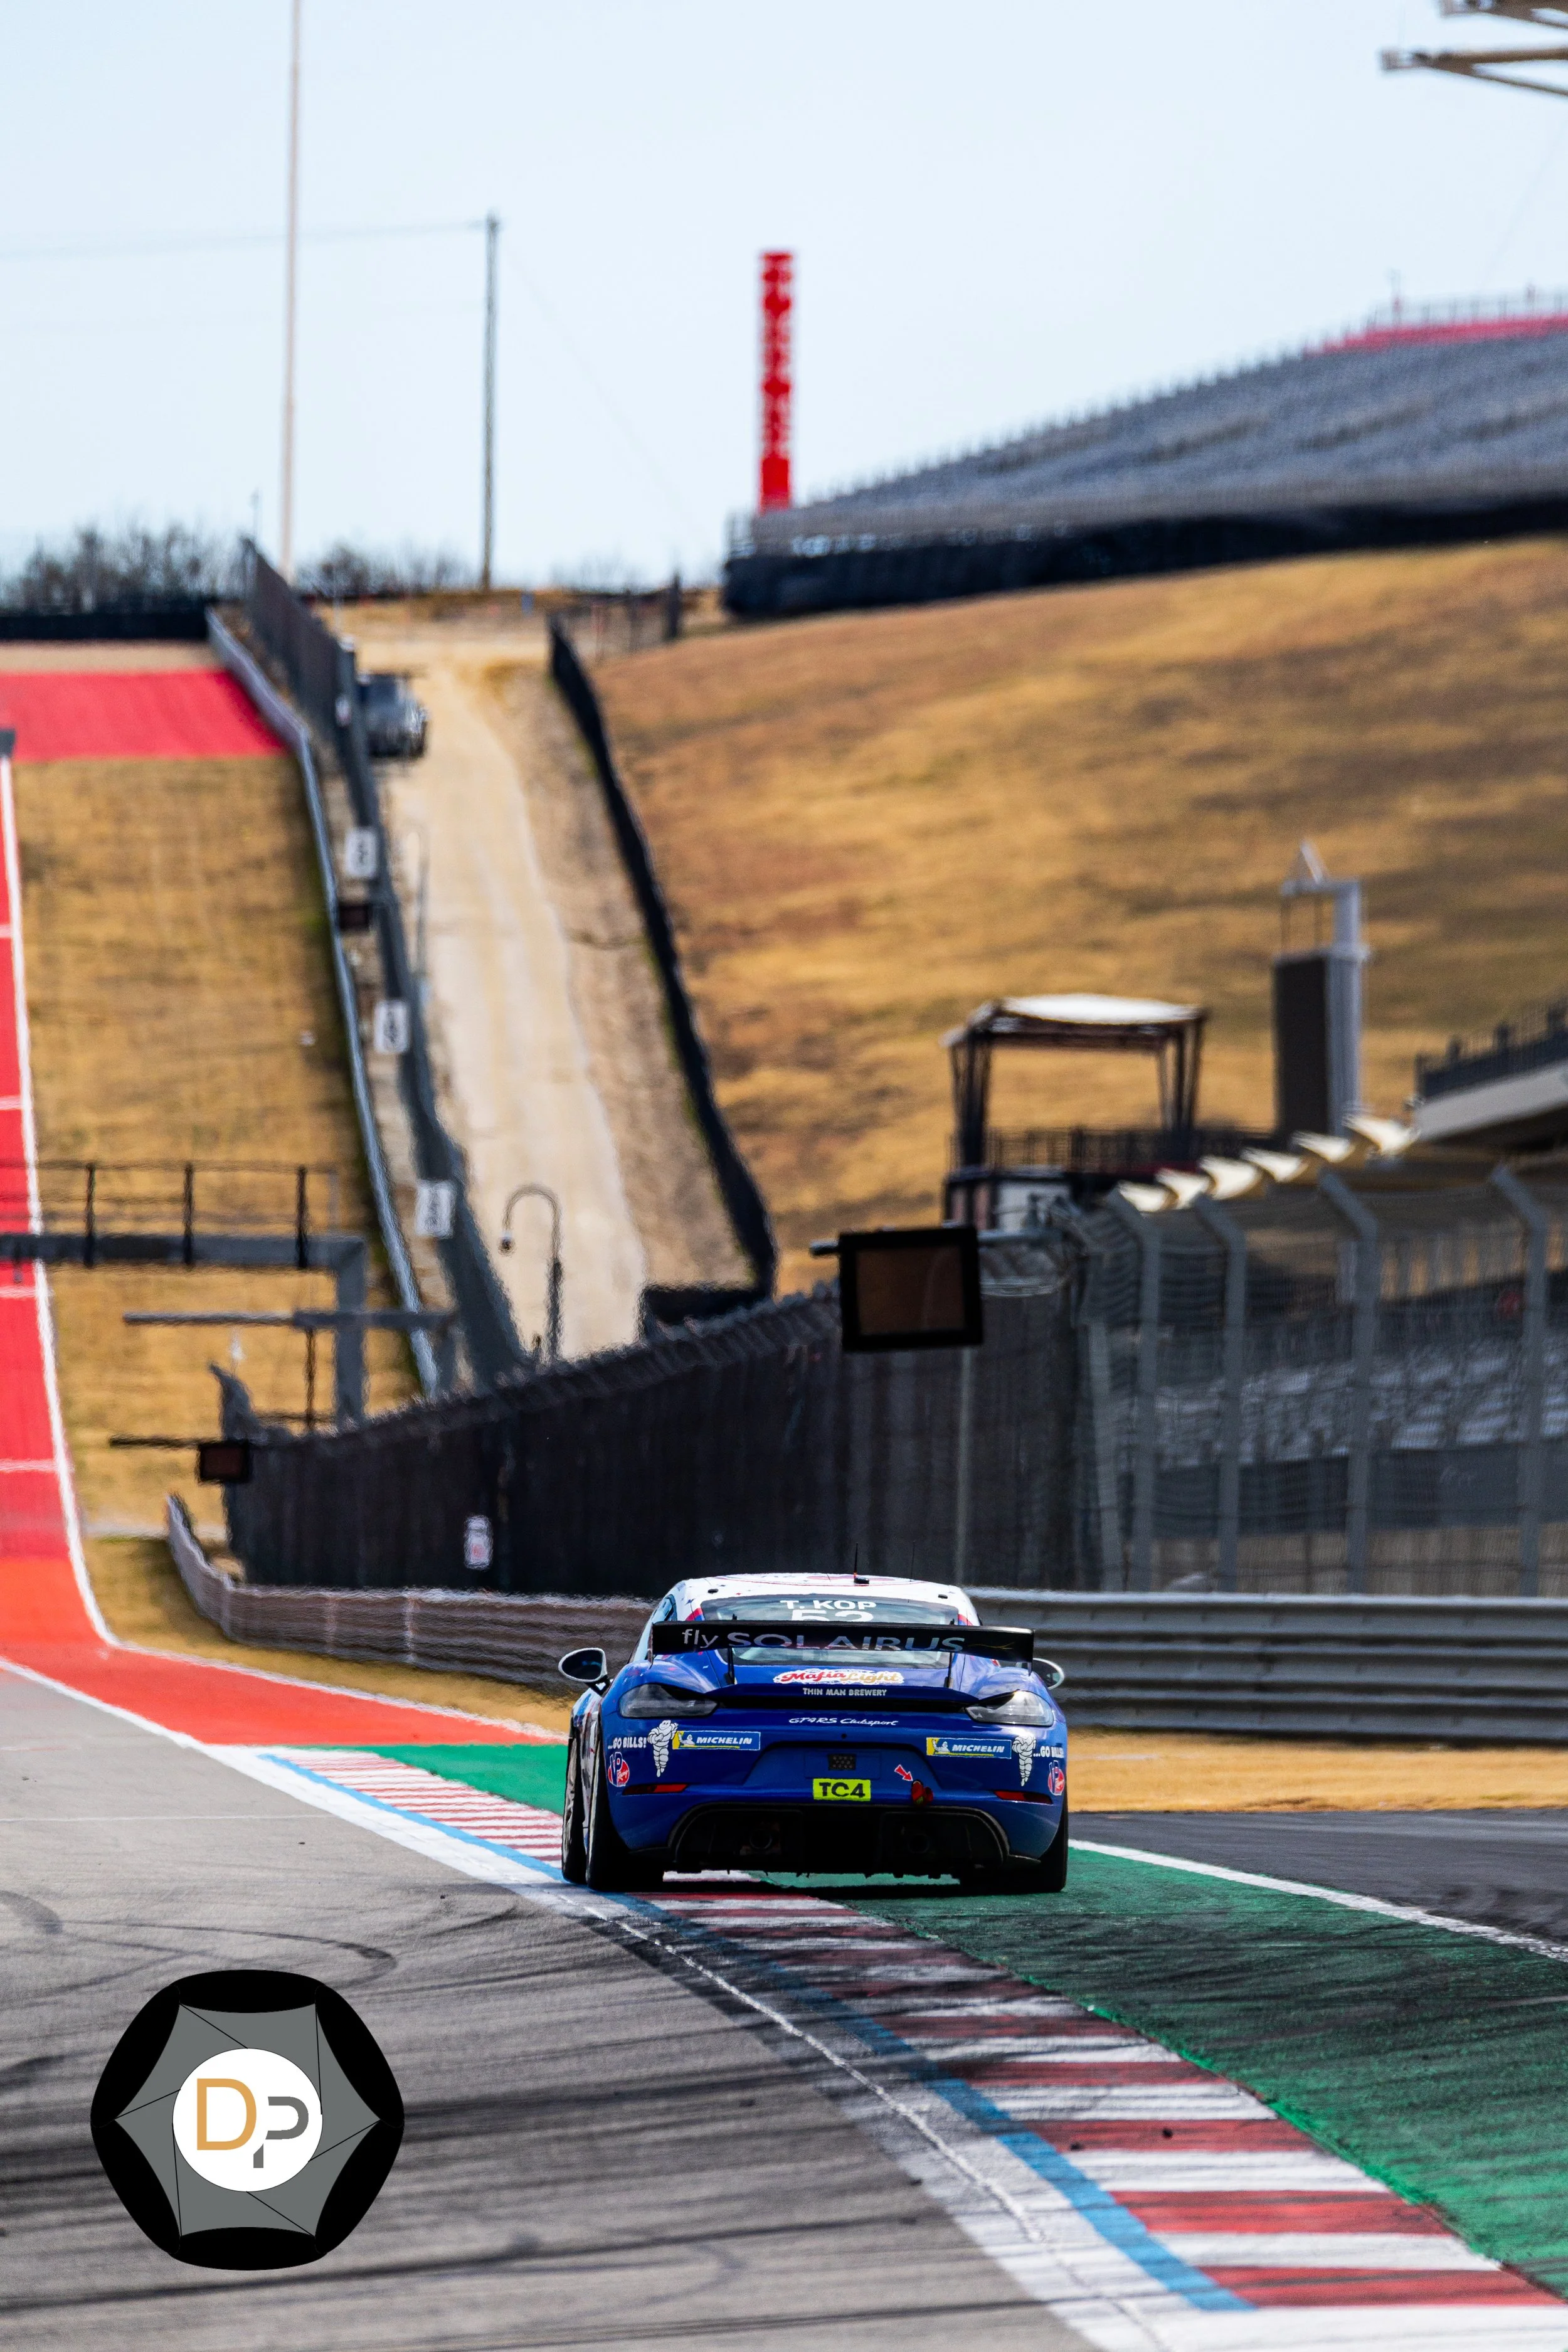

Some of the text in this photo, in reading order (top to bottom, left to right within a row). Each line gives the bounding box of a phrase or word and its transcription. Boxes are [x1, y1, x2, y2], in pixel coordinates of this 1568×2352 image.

[780, 1600, 877, 1610] T. KOP
[682, 1629, 965, 1651] fly SOLAIRUS
[840, 1718, 899, 1726] Clubsport
[623, 1737, 647, 1749] BILLS!
[696, 1737, 752, 1745] MICHELIN
[952, 1744, 1005, 1753] MICHELIN
[819, 1782, 866, 1798] TC4
